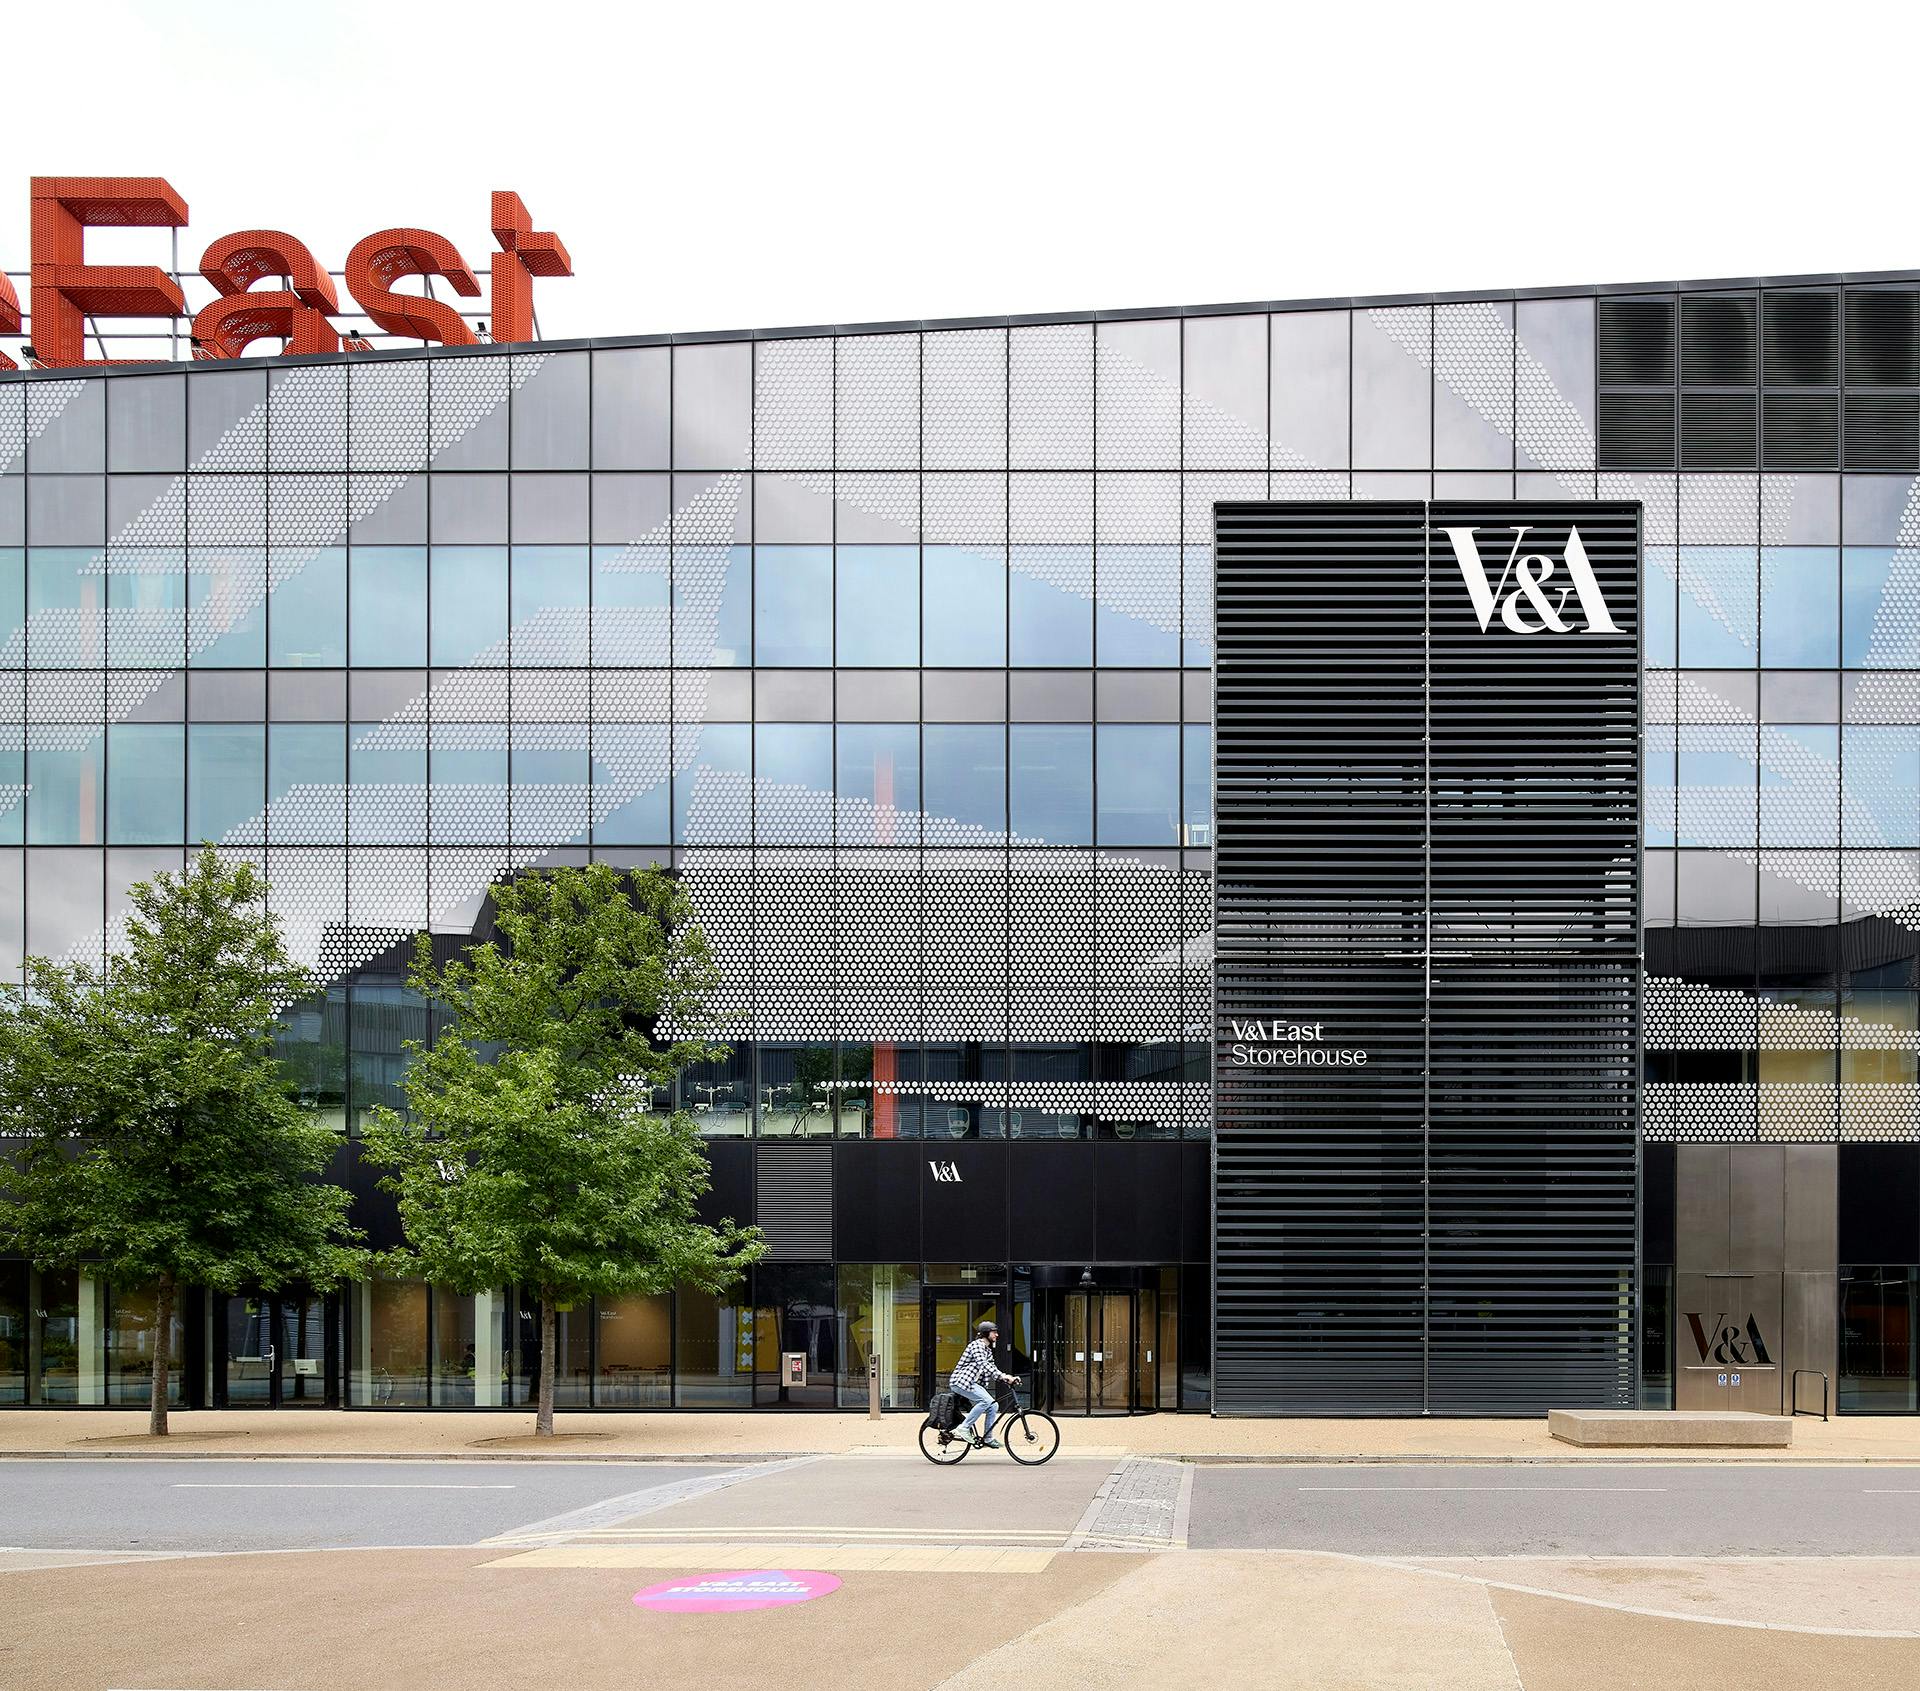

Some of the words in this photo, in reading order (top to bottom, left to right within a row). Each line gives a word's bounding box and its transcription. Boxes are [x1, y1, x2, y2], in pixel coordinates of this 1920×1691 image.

[30, 176, 572, 369] East
[1438, 524, 1628, 635] V&A
[1231, 1020, 1268, 1041] V&A
[1272, 1020, 1324, 1041] East
[1231, 1044, 1367, 1066] Storehouse
[928, 1161, 963, 1182] V&A
[1682, 1312, 1776, 1364] V&A
